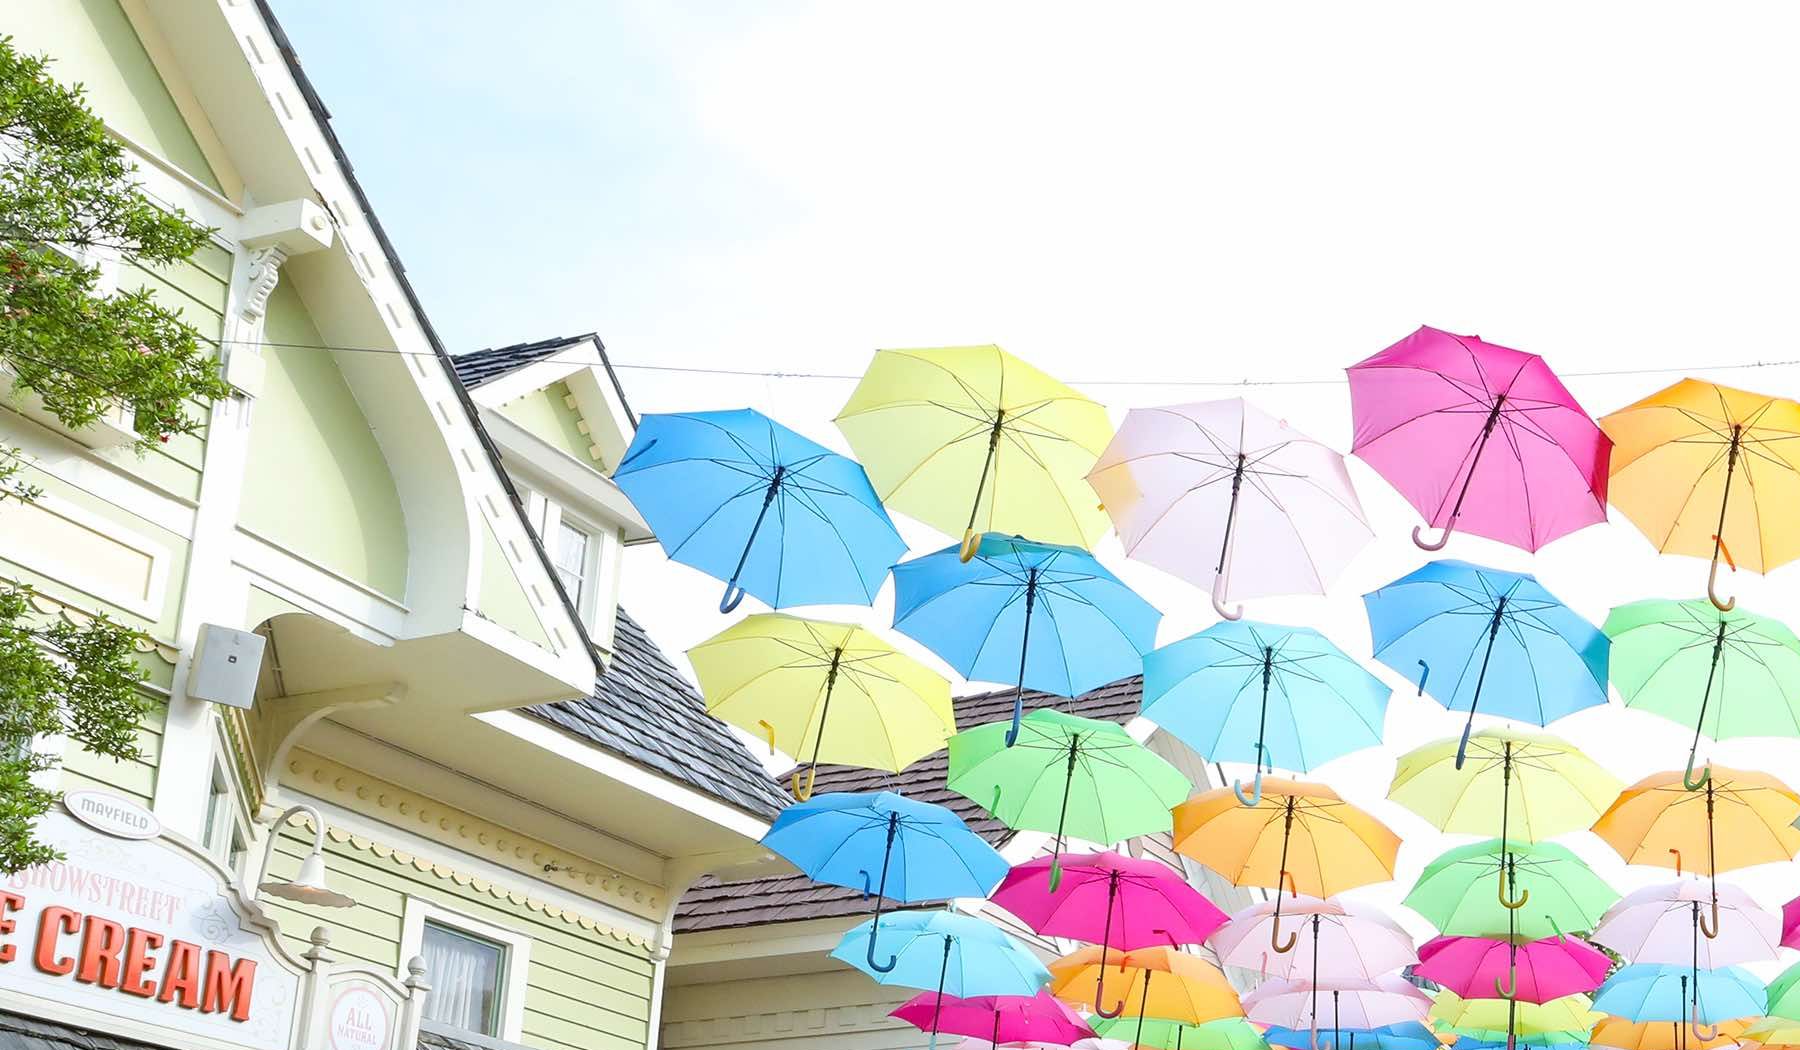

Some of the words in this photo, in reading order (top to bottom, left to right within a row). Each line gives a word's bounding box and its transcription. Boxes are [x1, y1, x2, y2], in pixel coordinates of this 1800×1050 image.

[81, 797, 149, 831] MAYFIELD
[34, 904, 258, 1022] CREAM
[346, 1007, 372, 1031] ALL
[337, 1024, 377, 1046] NATURAL
